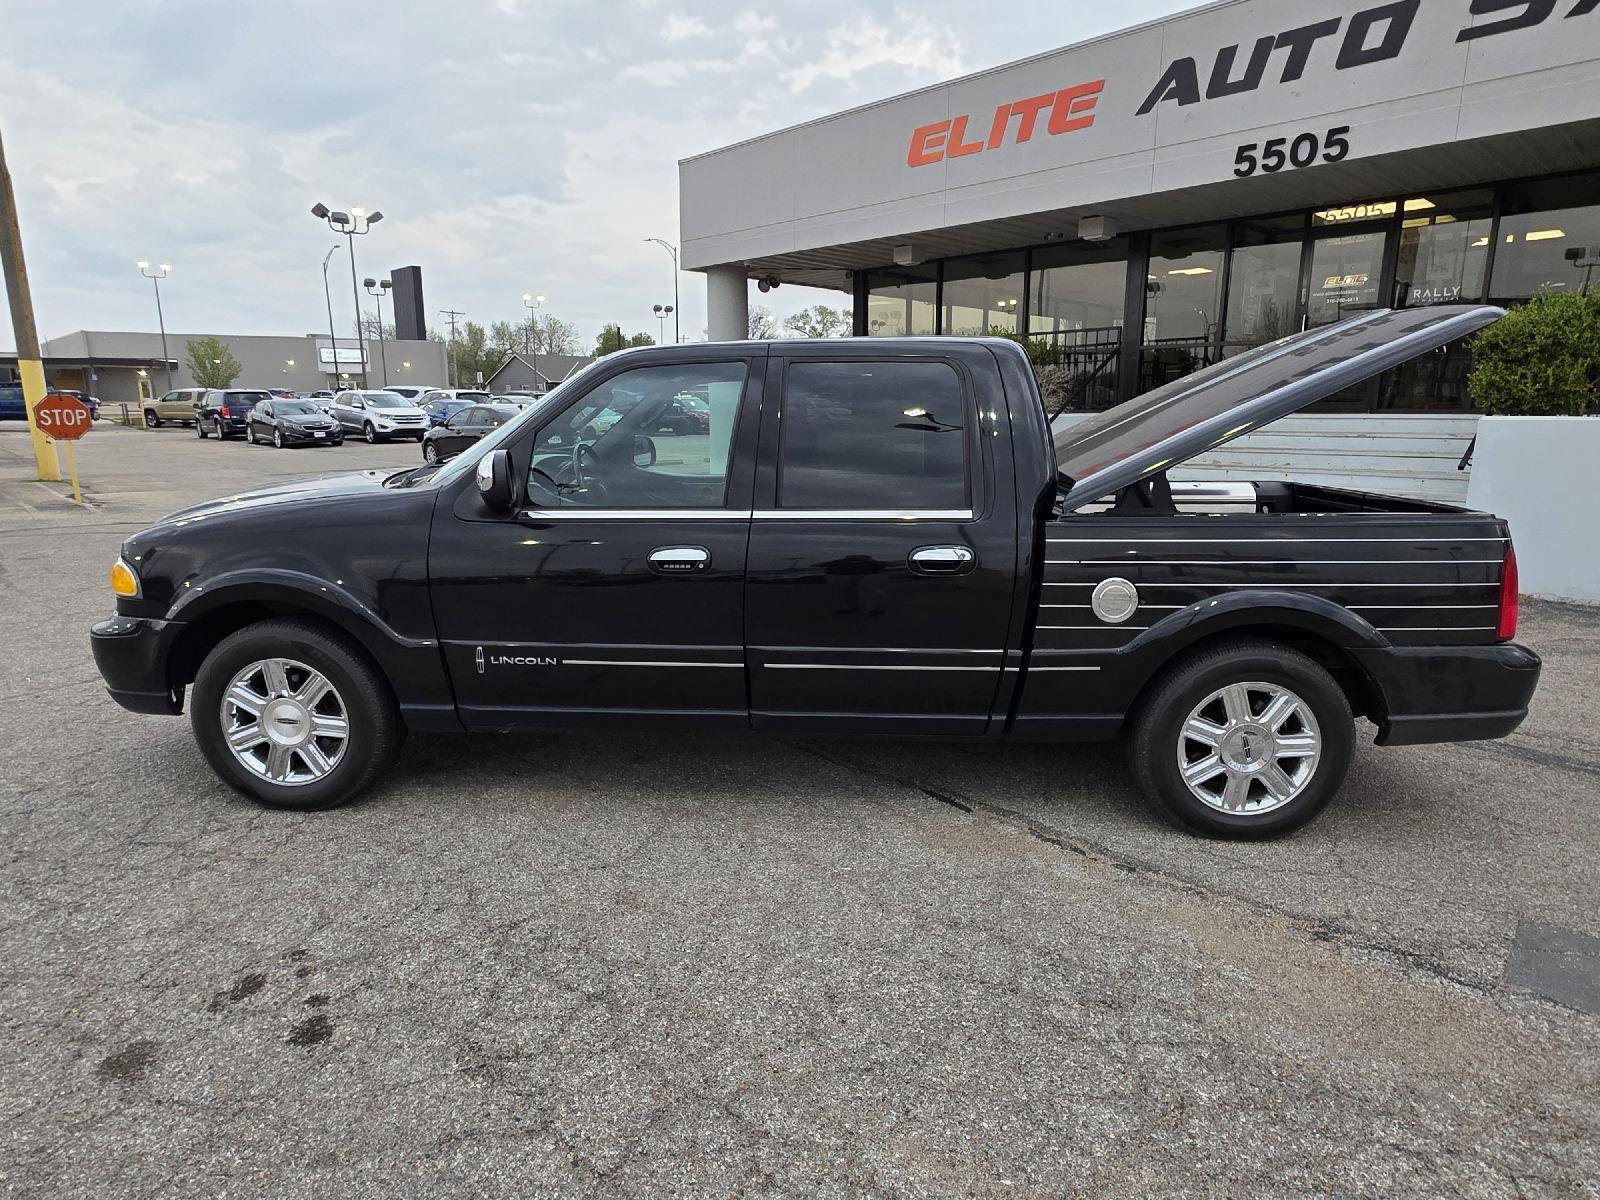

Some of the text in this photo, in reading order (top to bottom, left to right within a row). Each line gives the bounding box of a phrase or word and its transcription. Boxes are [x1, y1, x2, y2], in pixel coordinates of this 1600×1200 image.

[907, 79, 1105, 168] ELITE
[1135, 0, 1421, 116] AUTO
[1233, 125, 1350, 178] 5505
[1323, 202, 1384, 226] 5505
[1413, 286, 1460, 299] RALLY
[39, 409, 87, 426] STOP
[490, 655, 557, 666] LINCOLN
